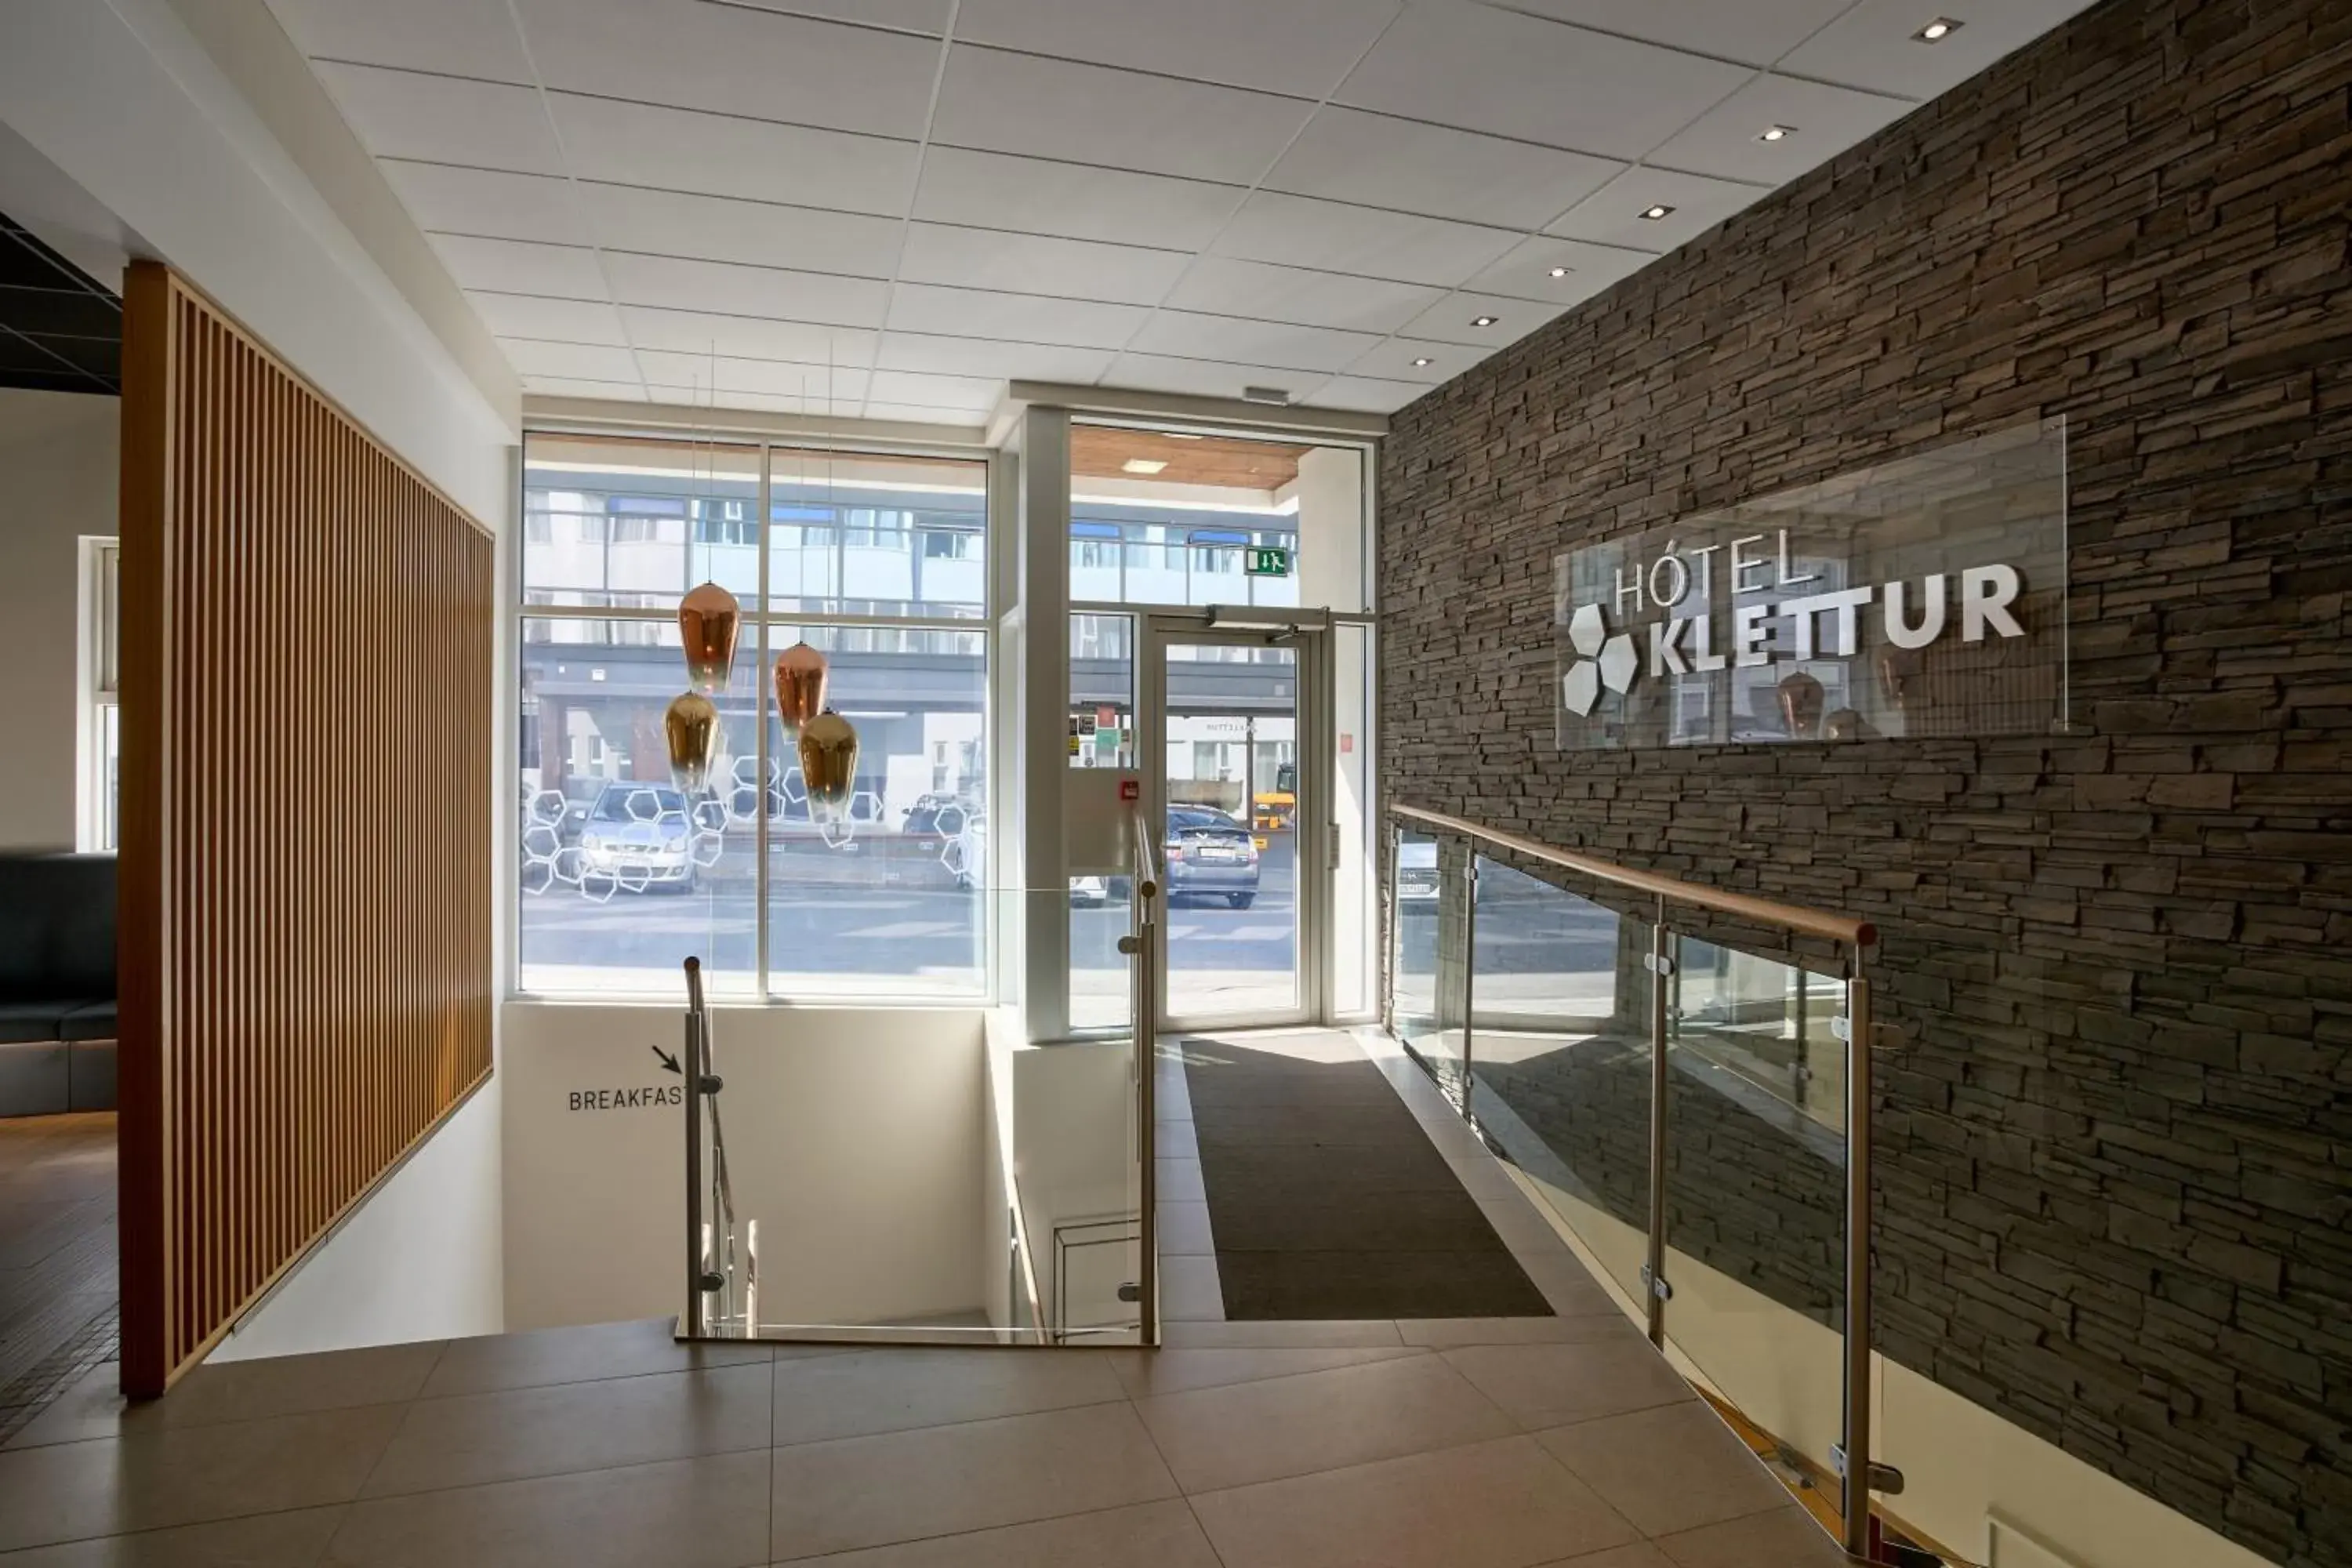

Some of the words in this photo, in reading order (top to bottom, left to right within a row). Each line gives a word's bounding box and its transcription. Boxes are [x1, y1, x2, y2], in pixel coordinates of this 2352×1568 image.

[1616, 529, 1815, 615] HÓTEL
[1650, 564, 2025, 677] KLETTUR
[569, 1086, 686, 1111] BREAKFAS
